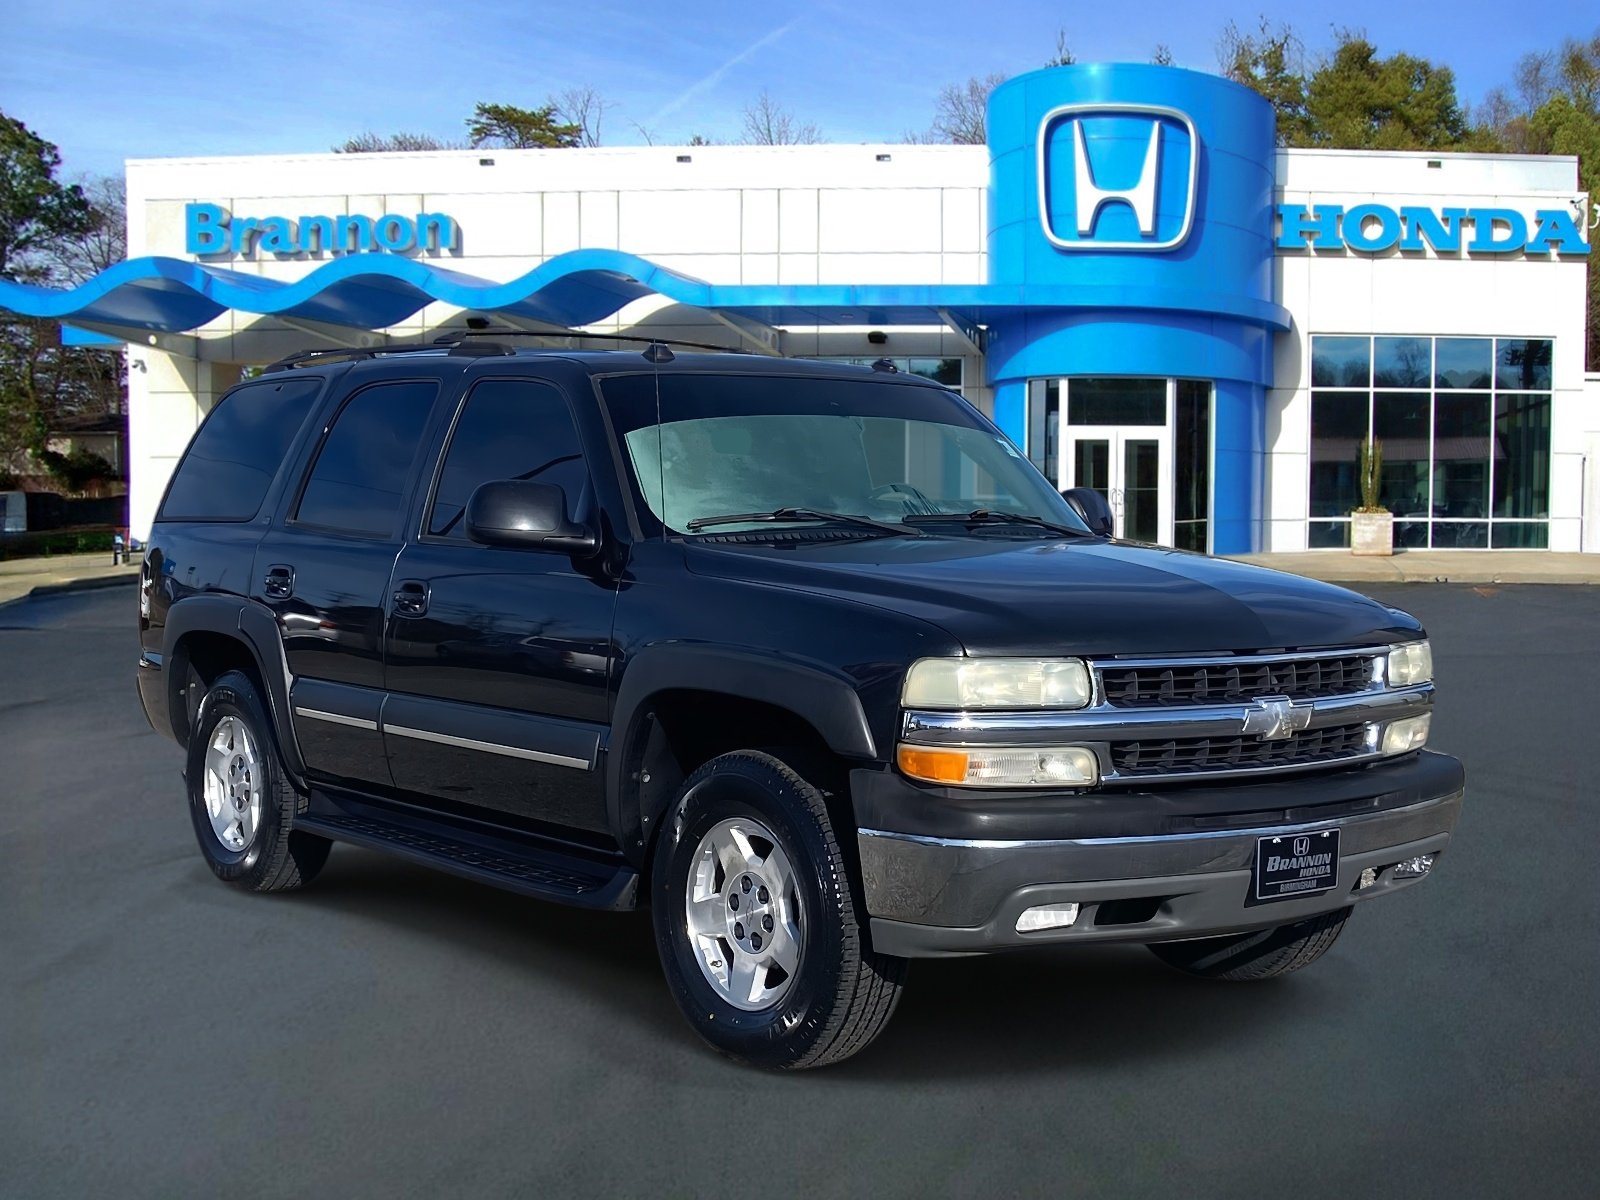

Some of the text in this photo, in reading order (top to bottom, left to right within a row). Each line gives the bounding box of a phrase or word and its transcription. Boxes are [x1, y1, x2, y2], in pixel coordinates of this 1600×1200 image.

[185, 202, 459, 254] Brannon
[1276, 203, 1592, 255] HONDA
[1299, 865, 1331, 877] HONDA
